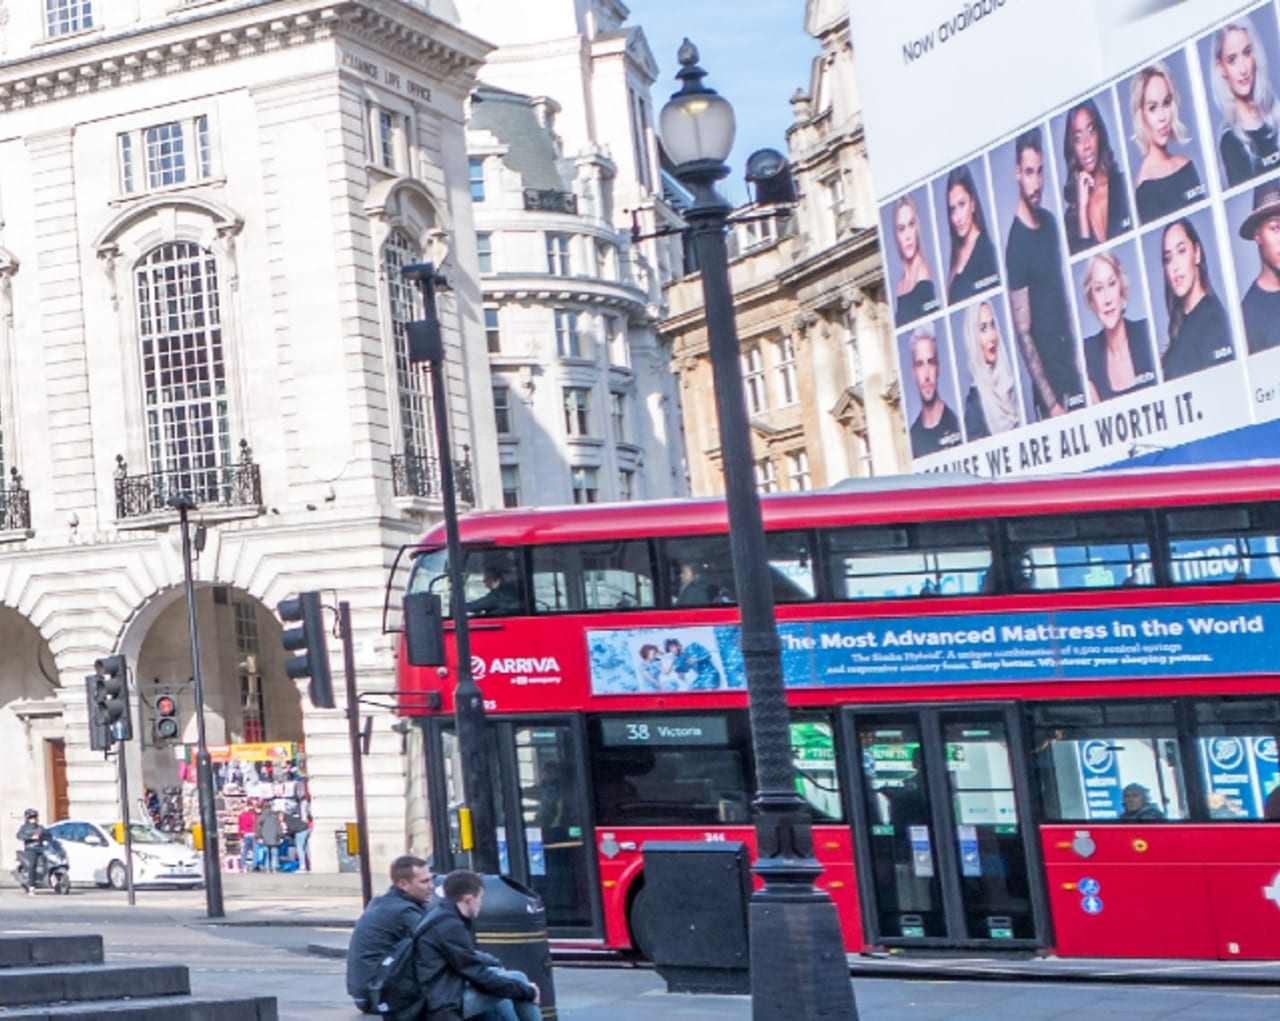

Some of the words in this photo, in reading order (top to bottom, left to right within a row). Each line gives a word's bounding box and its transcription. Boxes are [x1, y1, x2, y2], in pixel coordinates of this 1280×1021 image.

[902, 31, 934, 65] Now
[1255, 388, 1276, 404] Get
[985, 446, 1012, 478] WE
[1019, 434, 1052, 470] ARE
[1060, 423, 1090, 459] ALL
[1095, 404, 1168, 448] WORTH
[1176, 391, 1204, 425] IT.
[820, 632, 878, 649] Most
[882, 625, 997, 648] Advanced
[1001, 624, 1109, 643] Mattress
[1112, 621, 1137, 639] in
[1141, 619, 1184, 638] the
[1187, 615, 1265, 635] World
[490, 657, 560, 674] ARRIVA
[626, 724, 650, 740] 38
[657, 725, 703, 738] Victoria
